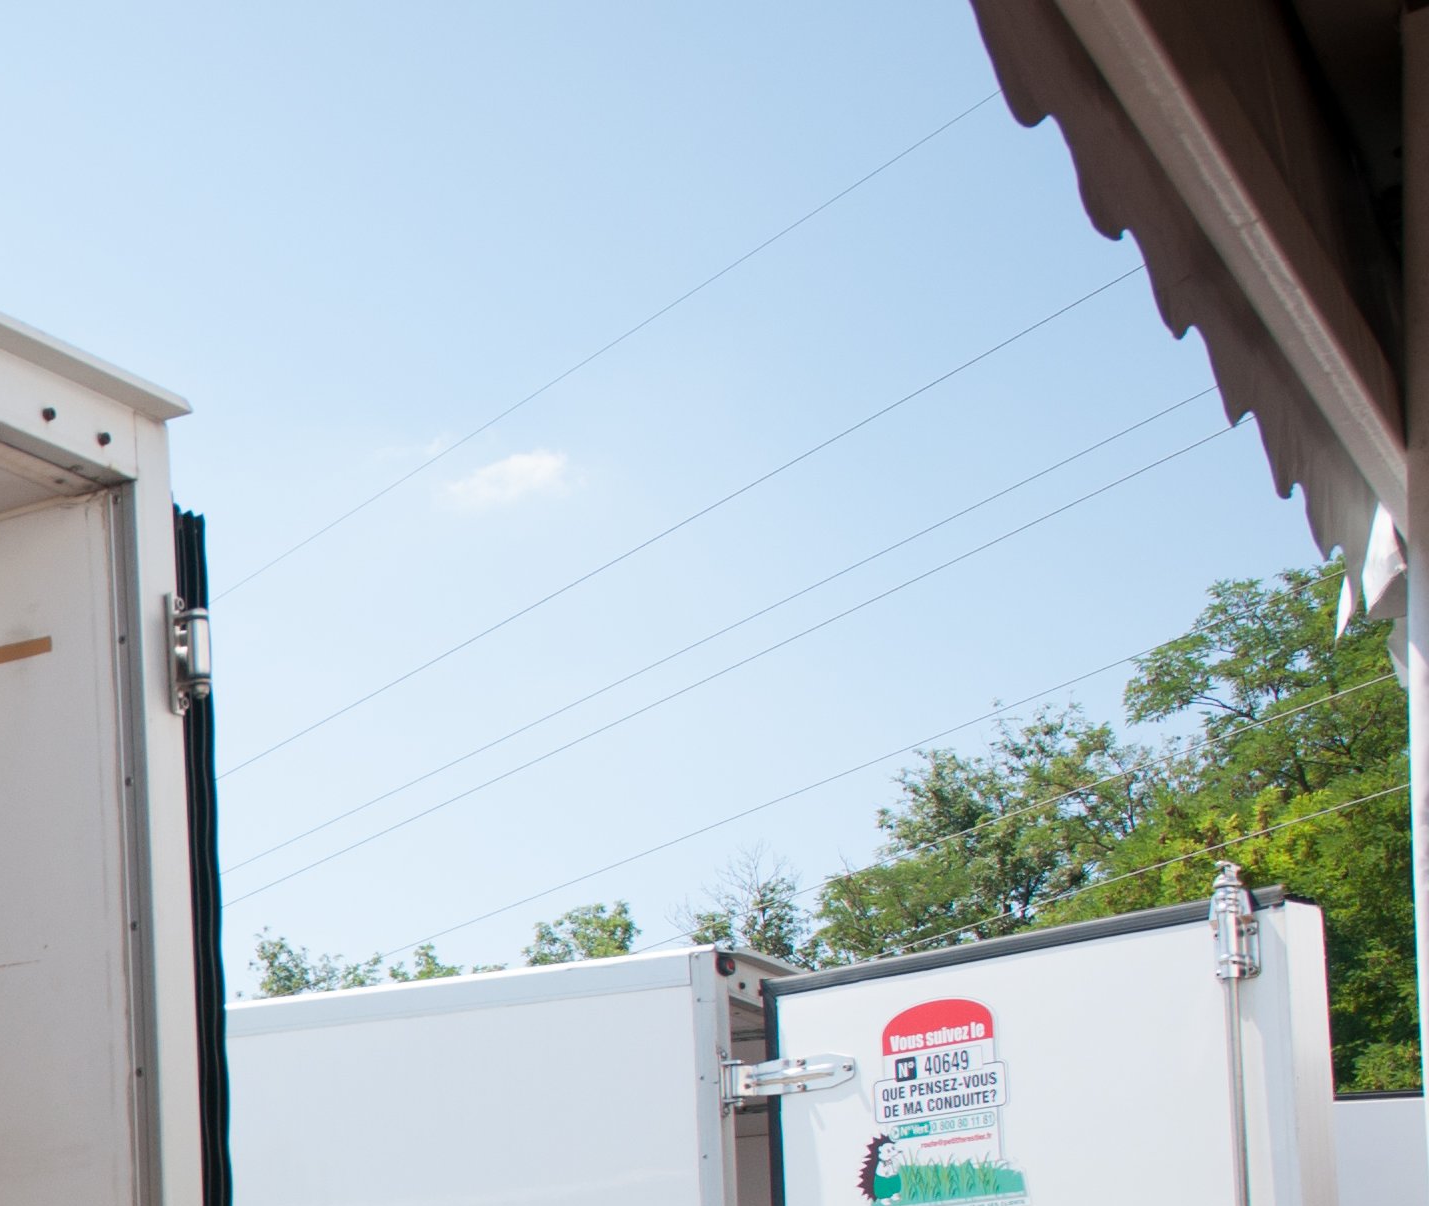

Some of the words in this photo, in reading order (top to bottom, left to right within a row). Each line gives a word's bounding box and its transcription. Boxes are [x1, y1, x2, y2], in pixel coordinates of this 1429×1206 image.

[889, 1033, 924, 1053] Vous
[925, 1026, 970, 1047] suivez
[970, 1021, 985, 1039] le
[898, 1060, 915, 1079] N°
[924, 1050, 969, 1075] 40649
[882, 1086, 906, 1102] QUE
[910, 1071, 998, 1097] PENSEZ-VOUS
[884, 1104, 900, 1119] DE
[903, 1101, 923, 1116] MA
[927, 1088, 998, 1112] CONDUITE?
